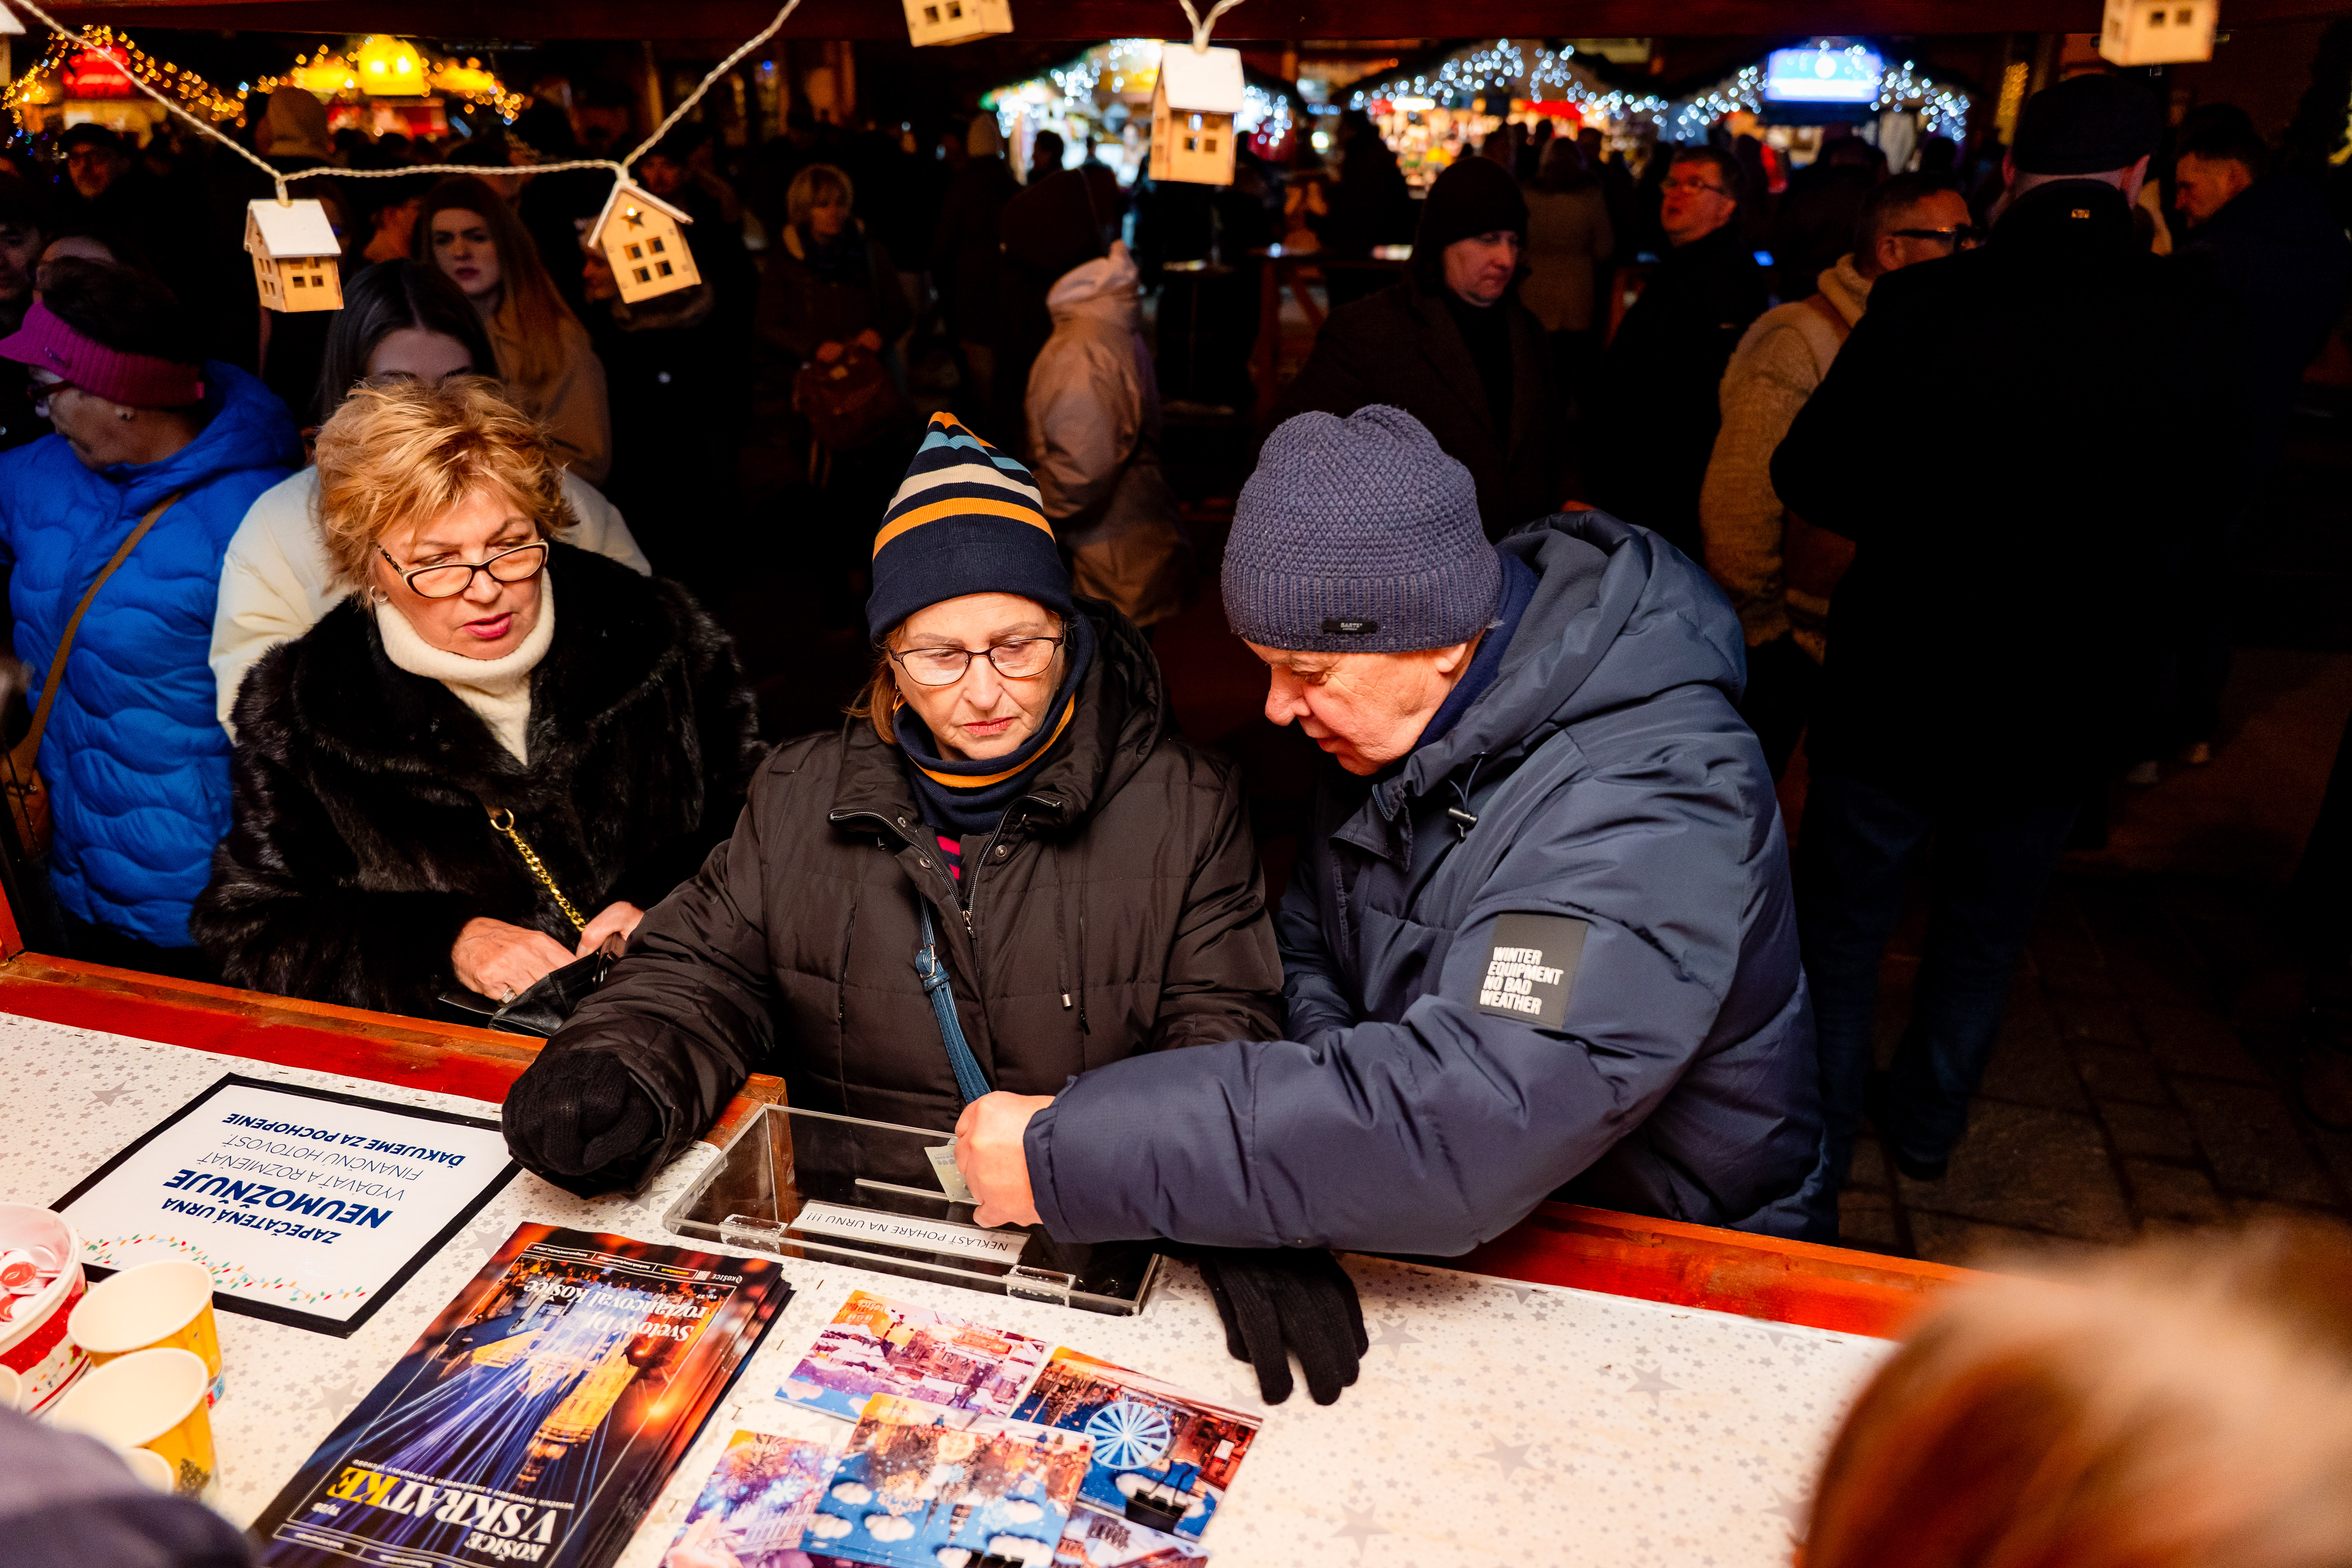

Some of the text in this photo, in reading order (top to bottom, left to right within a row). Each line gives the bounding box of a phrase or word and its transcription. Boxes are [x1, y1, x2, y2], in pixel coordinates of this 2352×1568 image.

[1493, 947, 1543, 965] WINTER
[1483, 975, 1532, 995] NO BAD
[1487, 961, 1564, 985] EQUIPMENT
[1479, 989, 1542, 1015] WEATHER
[222, 1113, 466, 1168] ĎAKUJEME ZA POCHOPENIE
[222, 1134, 423, 1180] FINANČNÚ HOTOVOSŤ.
[197, 1152, 405, 1201] VYDÁVAŤ A ROZMIEŇAŤ
[163, 1169, 394, 1229] NEUMOŽŇUJE
[161, 1198, 342, 1244] ZAPEČATENÁ URNA
[825, 1216, 865, 1228] URNU
[870, 1222, 888, 1232] NA
[890, 1226, 947, 1241] POHÁRE
[948, 1236, 1008, 1251] NEKLÁSŤ
[711, 1274, 735, 1282] KOŠICE
[524, 1281, 709, 1319] roztancoval Košice
[612, 1316, 695, 1341] Svetový
[464, 1531, 547, 1562] KOŠICE
